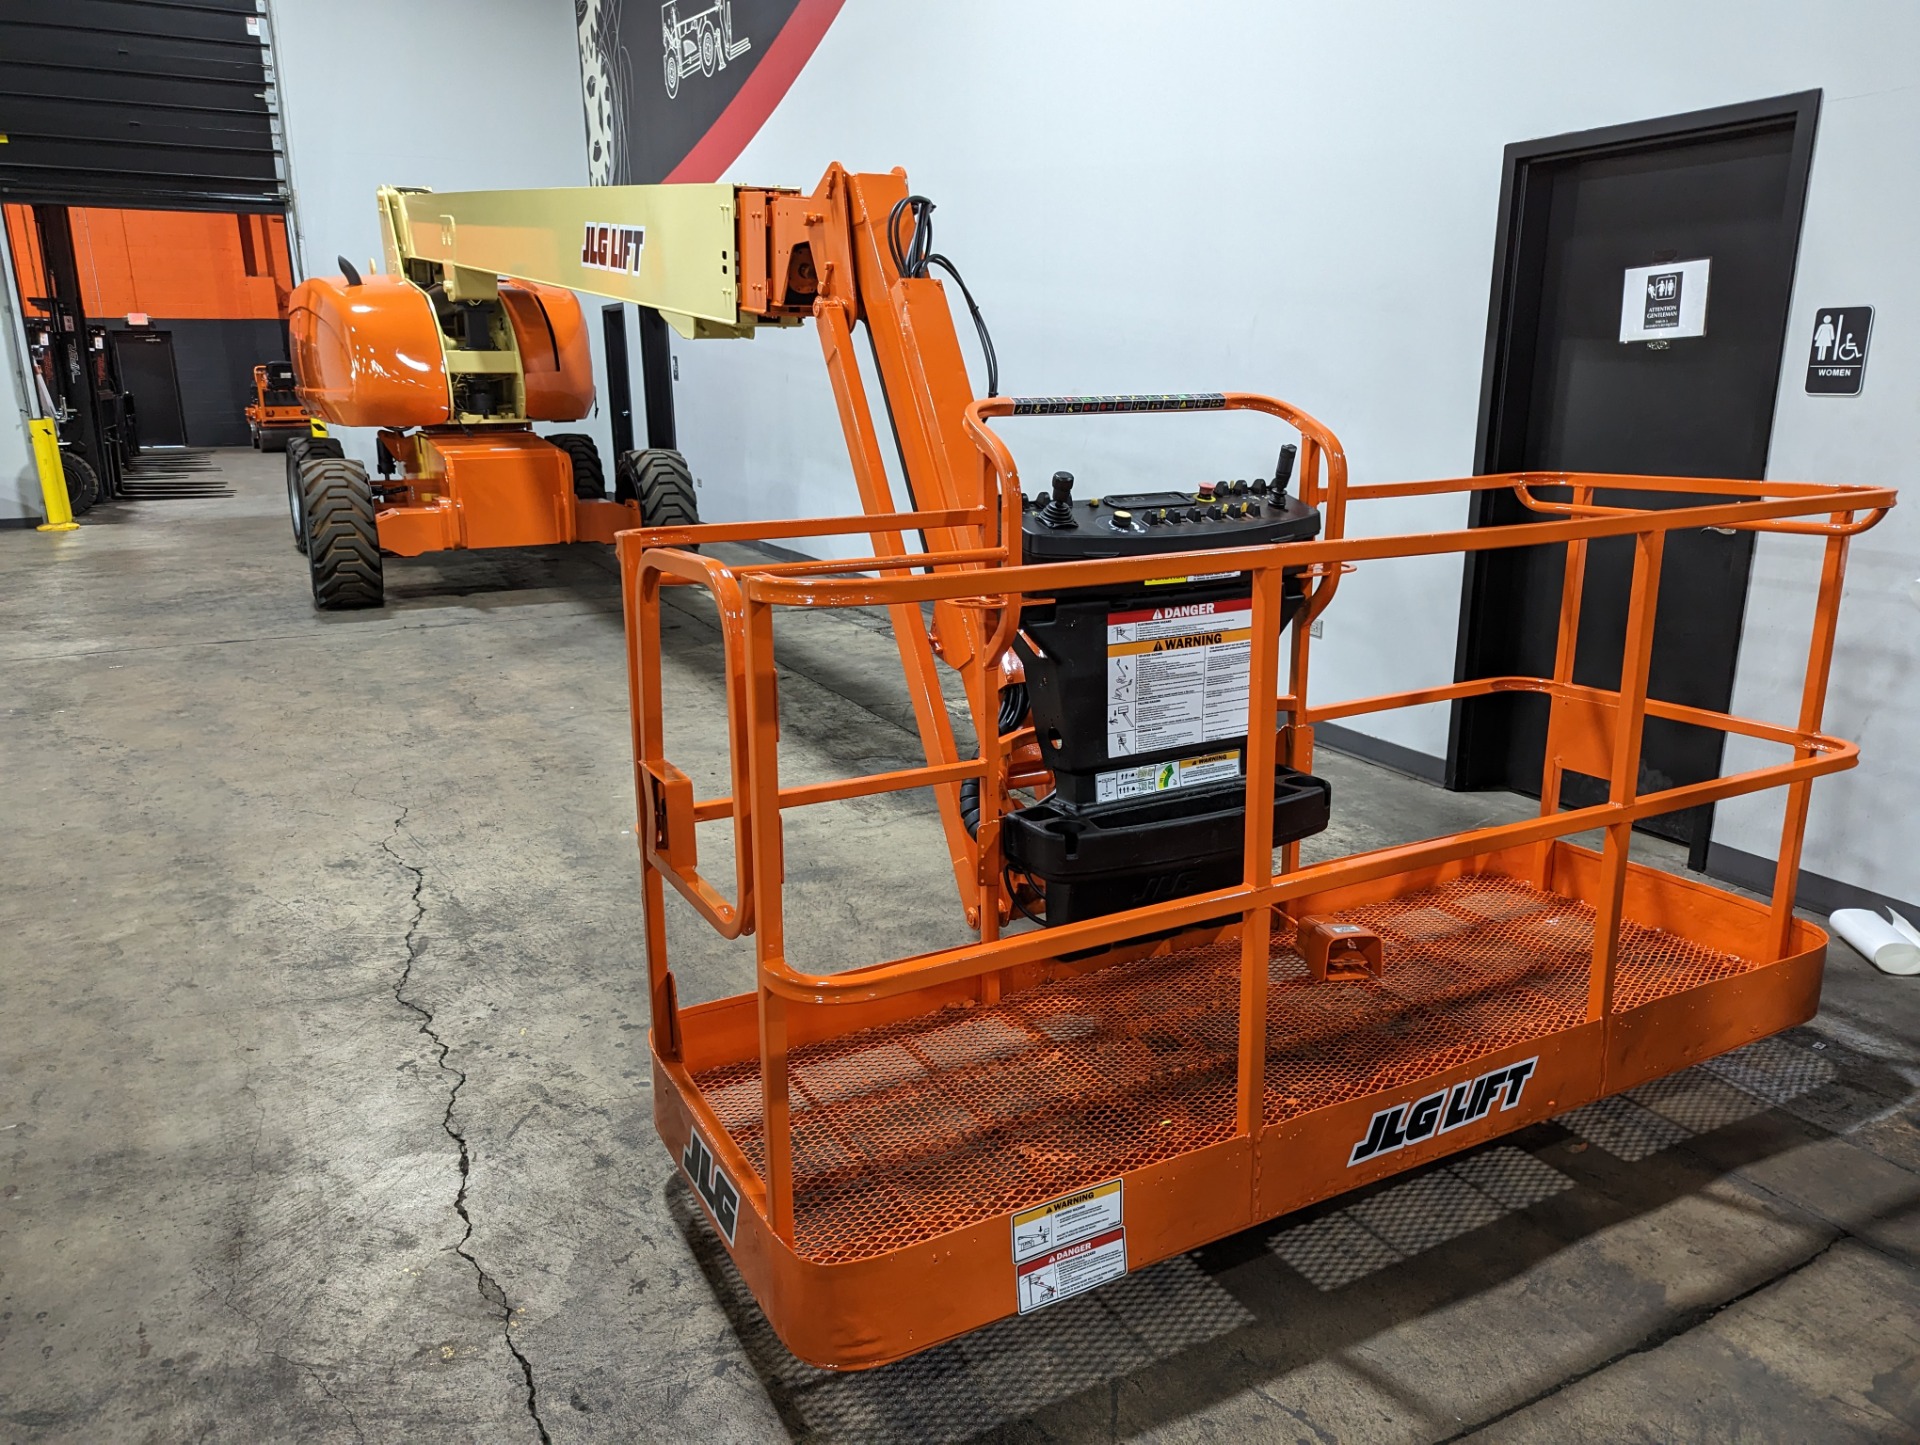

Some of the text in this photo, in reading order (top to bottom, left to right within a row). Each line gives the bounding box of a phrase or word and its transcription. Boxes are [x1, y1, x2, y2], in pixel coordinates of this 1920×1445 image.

[582, 225, 645, 273] JLG LIFT
[1646, 311, 1678, 319] GENTLEMAN
[1818, 368, 1852, 377] WOMEN
[1164, 603, 1215, 619] DANGER
[1165, 633, 1223, 651] WARNING
[1198, 754, 1227, 765] WARNING
[1350, 1060, 1536, 1163] JLG LIFT
[683, 1129, 739, 1245] JLG
[1053, 1192, 1094, 1211] WARNING
[1056, 1242, 1092, 1260] DANGER
